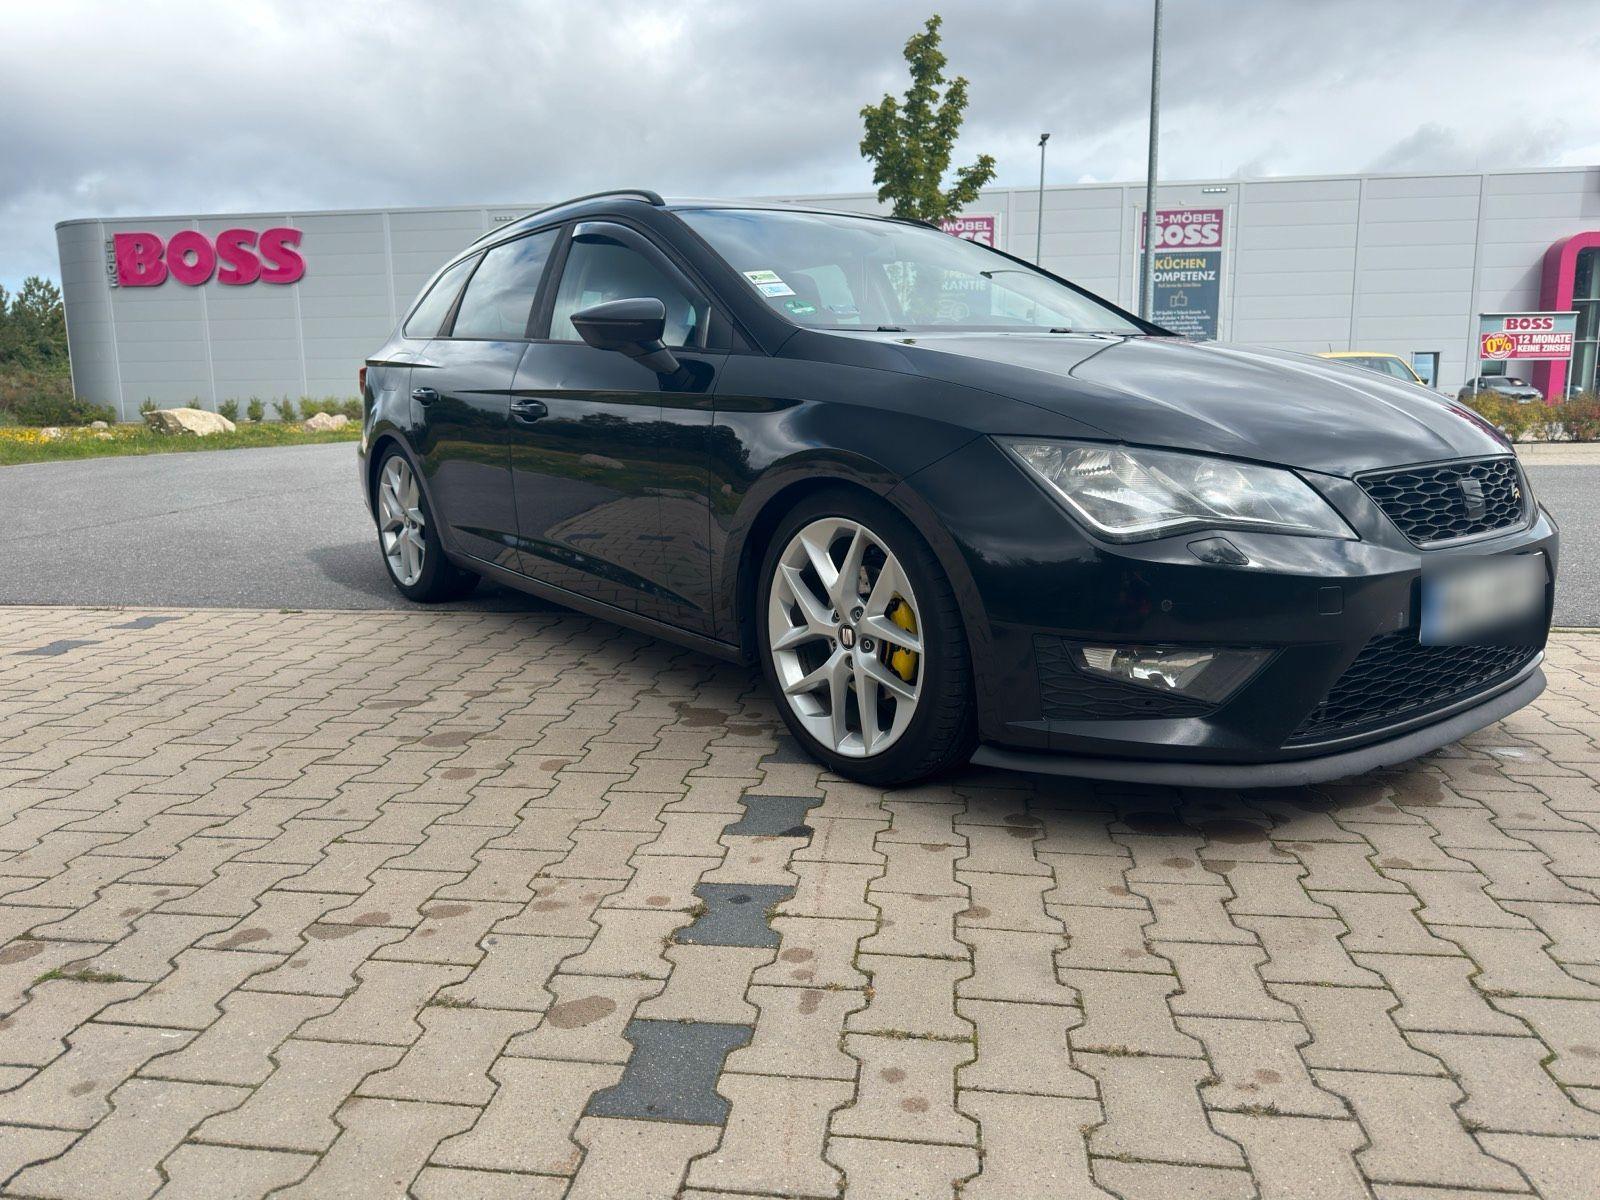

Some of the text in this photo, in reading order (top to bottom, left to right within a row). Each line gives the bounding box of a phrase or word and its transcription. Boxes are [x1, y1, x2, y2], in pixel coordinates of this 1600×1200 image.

[1144, 212, 1220, 224] B-MÖBEL
[113, 228, 305, 288] BOSS
[1155, 256, 1206, 270] KÜCHEN
[1154, 271, 1216, 282] OMPETENZ
[1505, 317, 1553, 330] BOSS
[1518, 334, 1571, 343] 12 MONATE
[1486, 337, 1512, 353] 0%
[1517, 343, 1571, 352] KEINE ZINSEN
